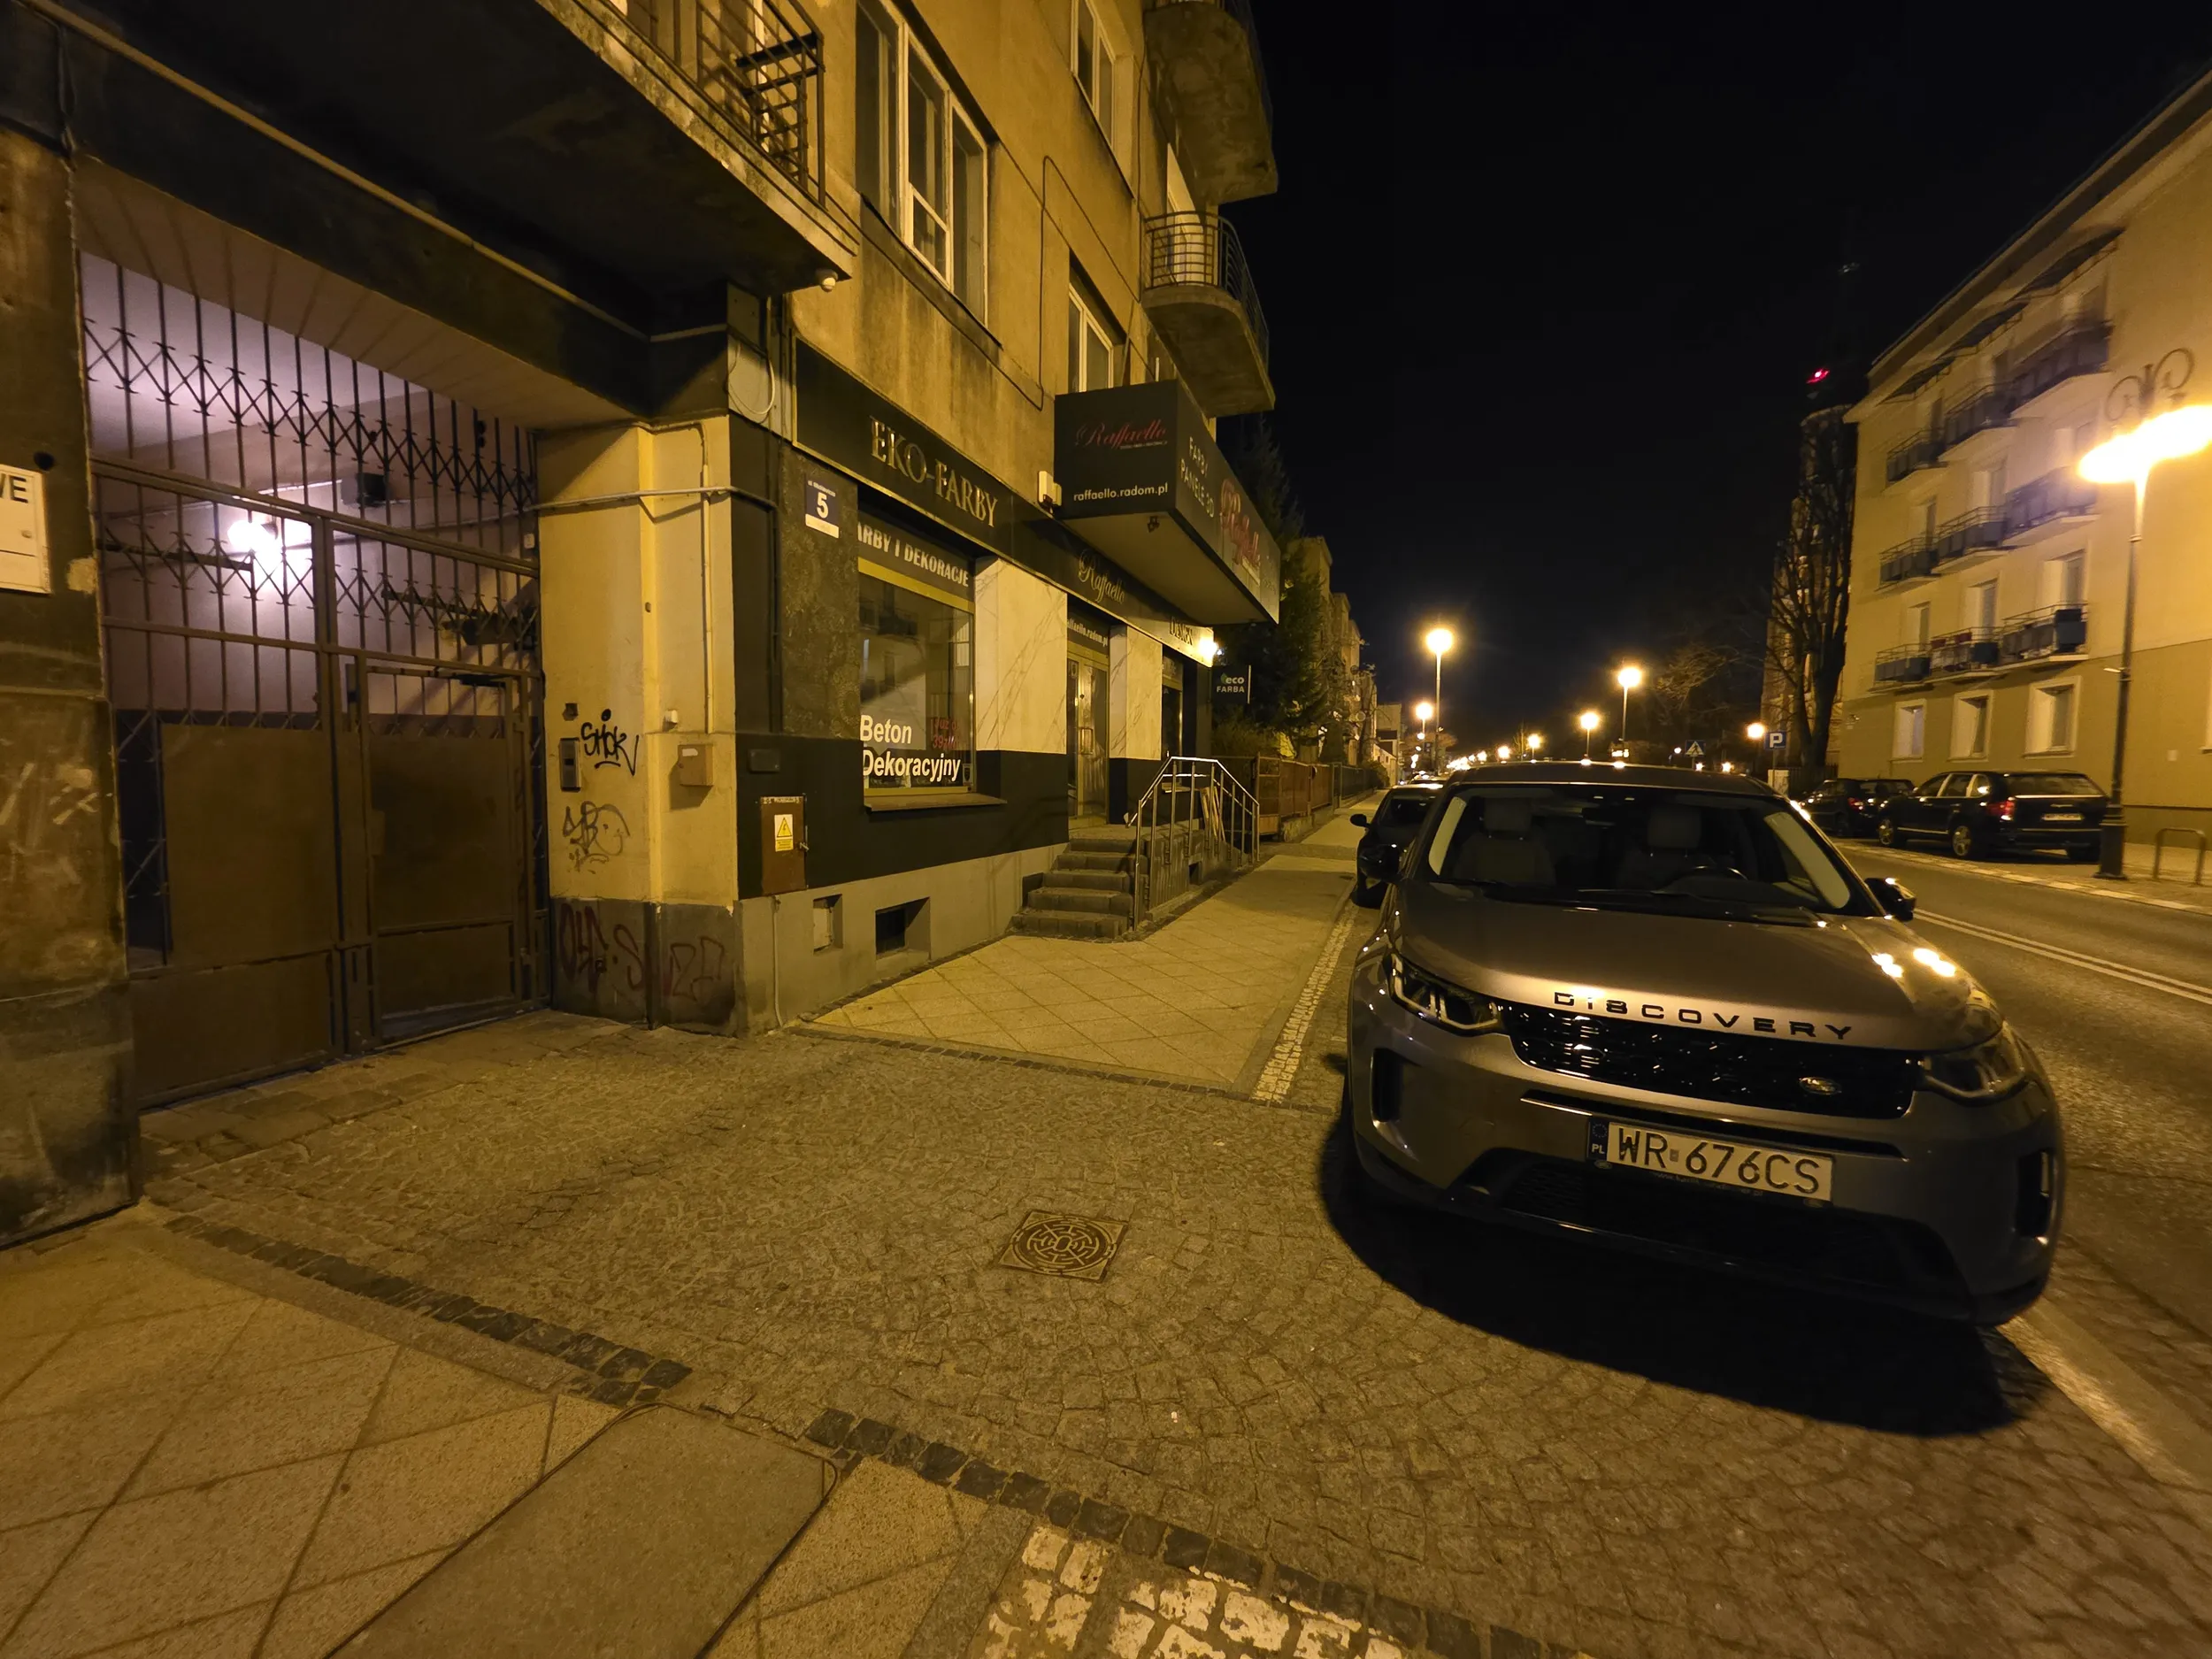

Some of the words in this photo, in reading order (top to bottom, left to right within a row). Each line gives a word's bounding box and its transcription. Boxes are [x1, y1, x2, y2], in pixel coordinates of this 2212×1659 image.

[1075, 419, 1167, 449] Raffaello
[869, 415, 998, 528] EKO-FARBY
[1180, 457, 1205, 507] PANELE
[817, 491, 829, 518] 5
[1073, 482, 1168, 502] raffaello.radom.pl
[857, 521, 892, 553] ARBY
[895, 538, 901, 557] I
[904, 542, 969, 588] DEKORACJE
[1079, 549, 1125, 604] Raffaello
[860, 714, 912, 744] Beton
[1770, 733, 1783, 749] P
[863, 749, 961, 783] Dekoracyjny
[1555, 991, 1852, 1041] DISCOVERY
[1592, 1143, 1605, 1155] PL
[1618, 1127, 1669, 1169] WR
[1685, 1141, 1821, 1194] 676CS
